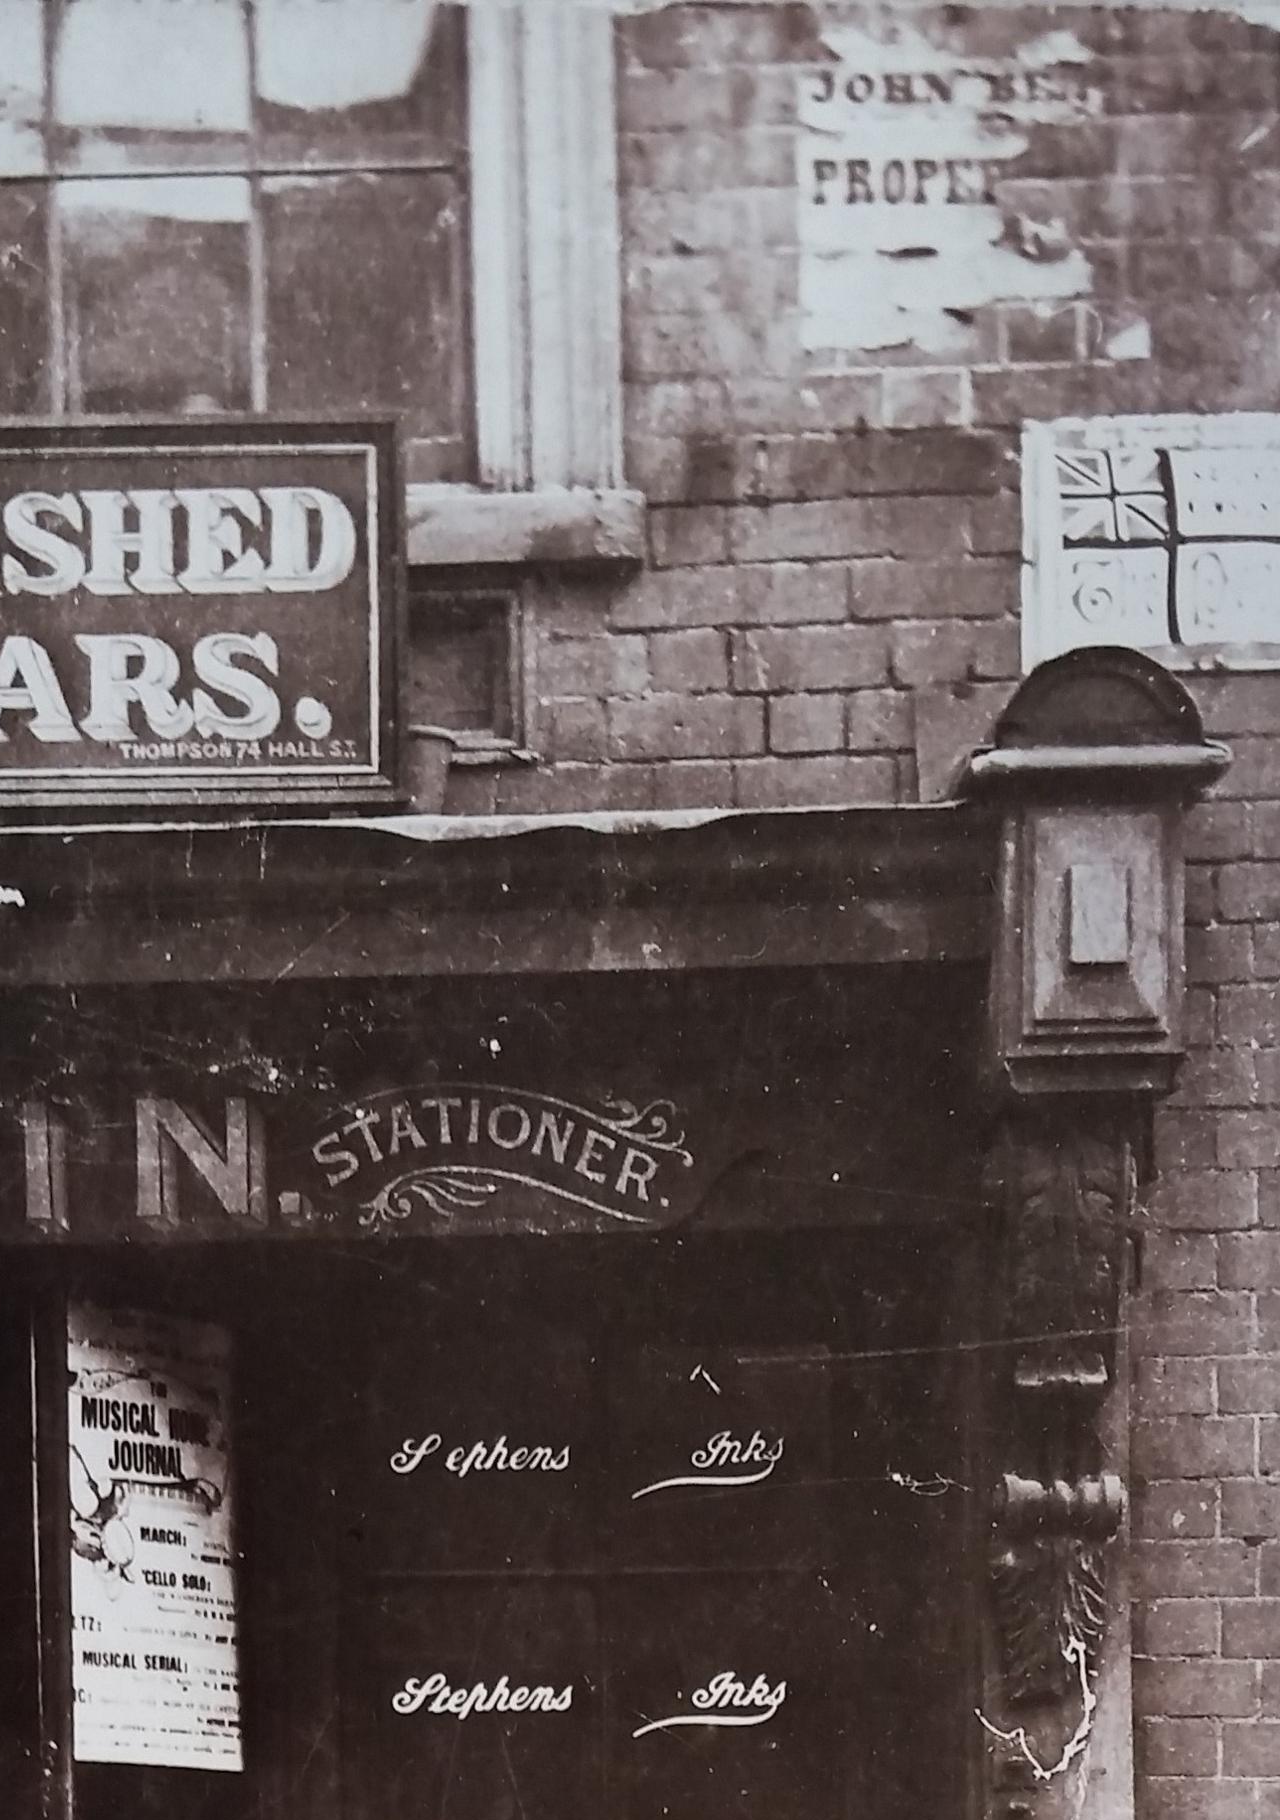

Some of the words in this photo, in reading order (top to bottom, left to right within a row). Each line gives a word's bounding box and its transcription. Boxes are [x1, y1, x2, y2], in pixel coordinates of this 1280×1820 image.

[812, 71, 952, 104] JOHN
[118, 740, 233, 762] THOMPSON
[235, 741, 262, 762] 74
[267, 741, 325, 759] HALL
[311, 1097, 670, 1207] STATIONER.
[81, 1396, 160, 1437] MUSICAL
[108, 1438, 186, 1481] JOURNAL
[390, 1434, 570, 1478] Sephens
[81, 1650, 137, 1670] MUSICAL
[392, 1672, 574, 1721] Stephens
